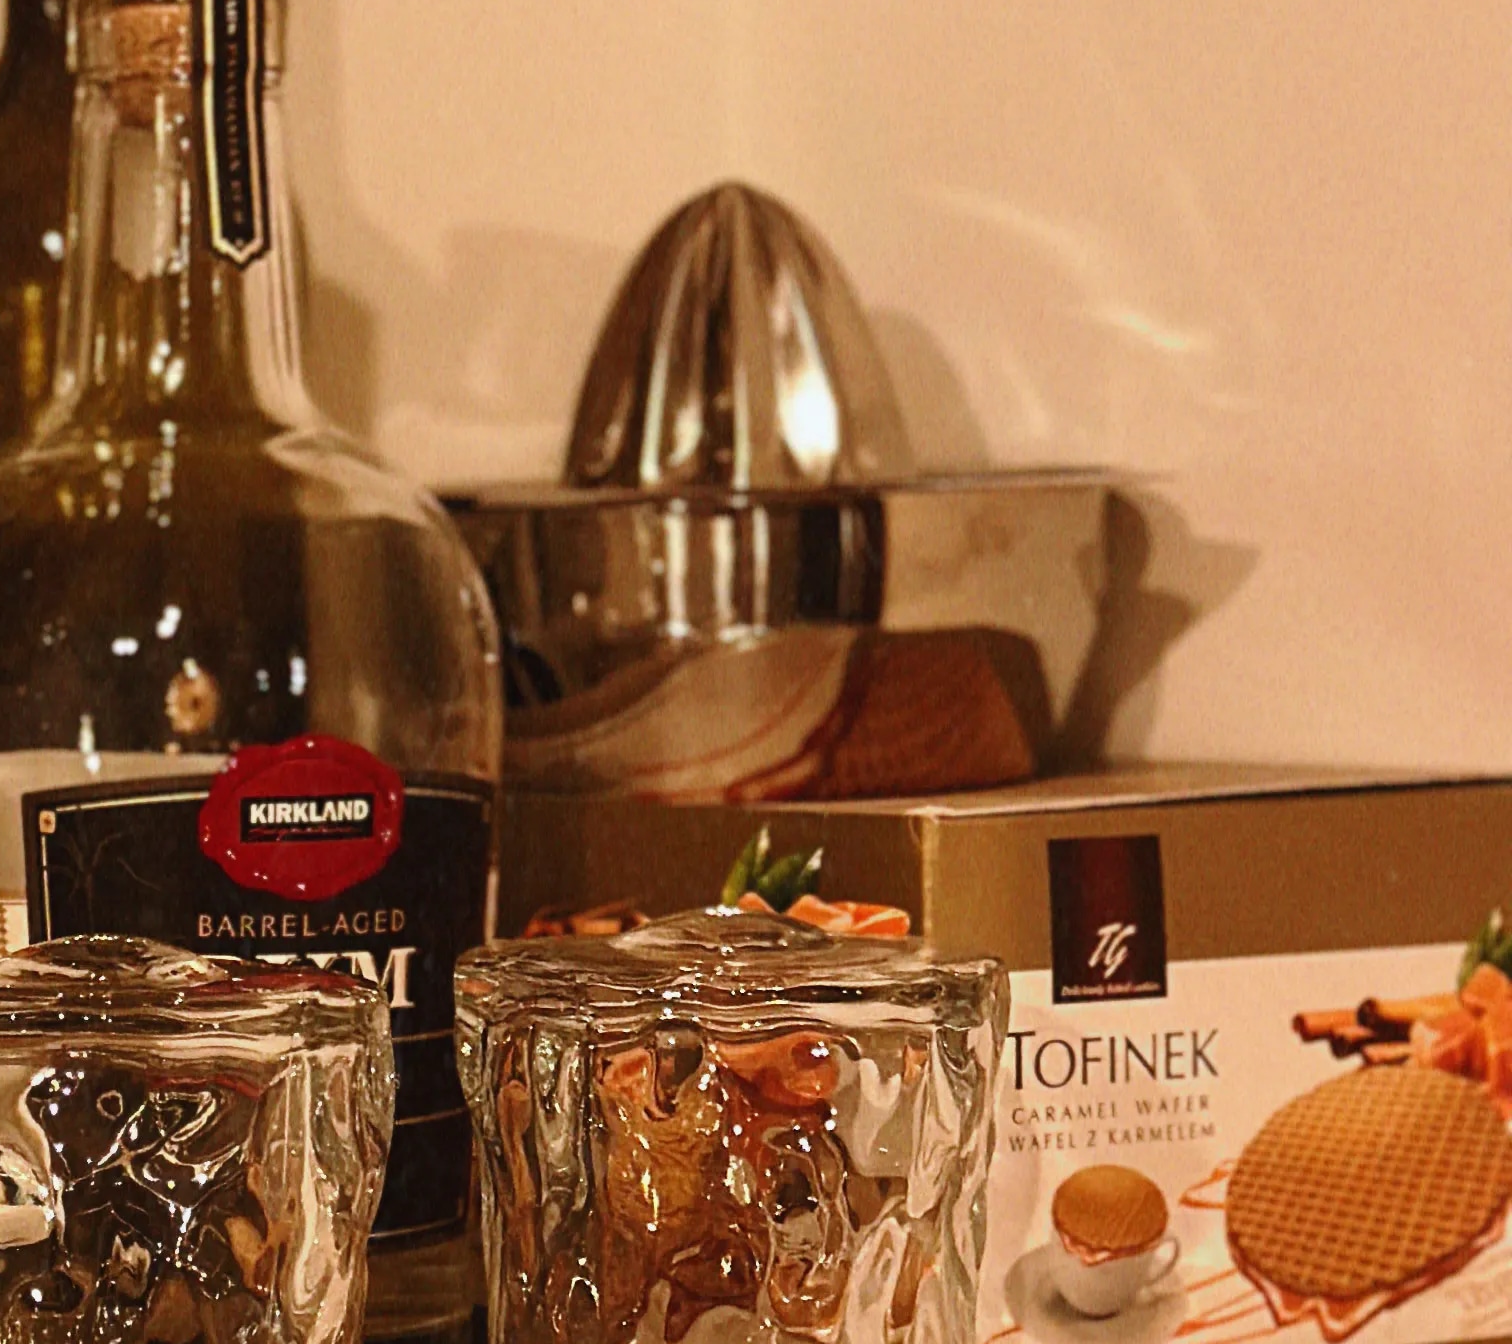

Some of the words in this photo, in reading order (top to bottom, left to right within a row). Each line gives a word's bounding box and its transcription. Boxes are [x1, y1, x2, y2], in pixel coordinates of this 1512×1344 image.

[249, 799, 370, 824] KIRKLAND
[198, 909, 406, 938] BARREL-AGED
[1006, 1028, 1220, 1090] TOFINEK
[1011, 1101, 1119, 1126] CARAMEL
[1135, 1094, 1211, 1116] WAFER
[1008, 1132, 1077, 1153] WAFEL
[1085, 1130, 1098, 1148] Z
[1107, 1121, 1217, 1146] KARMELEM
